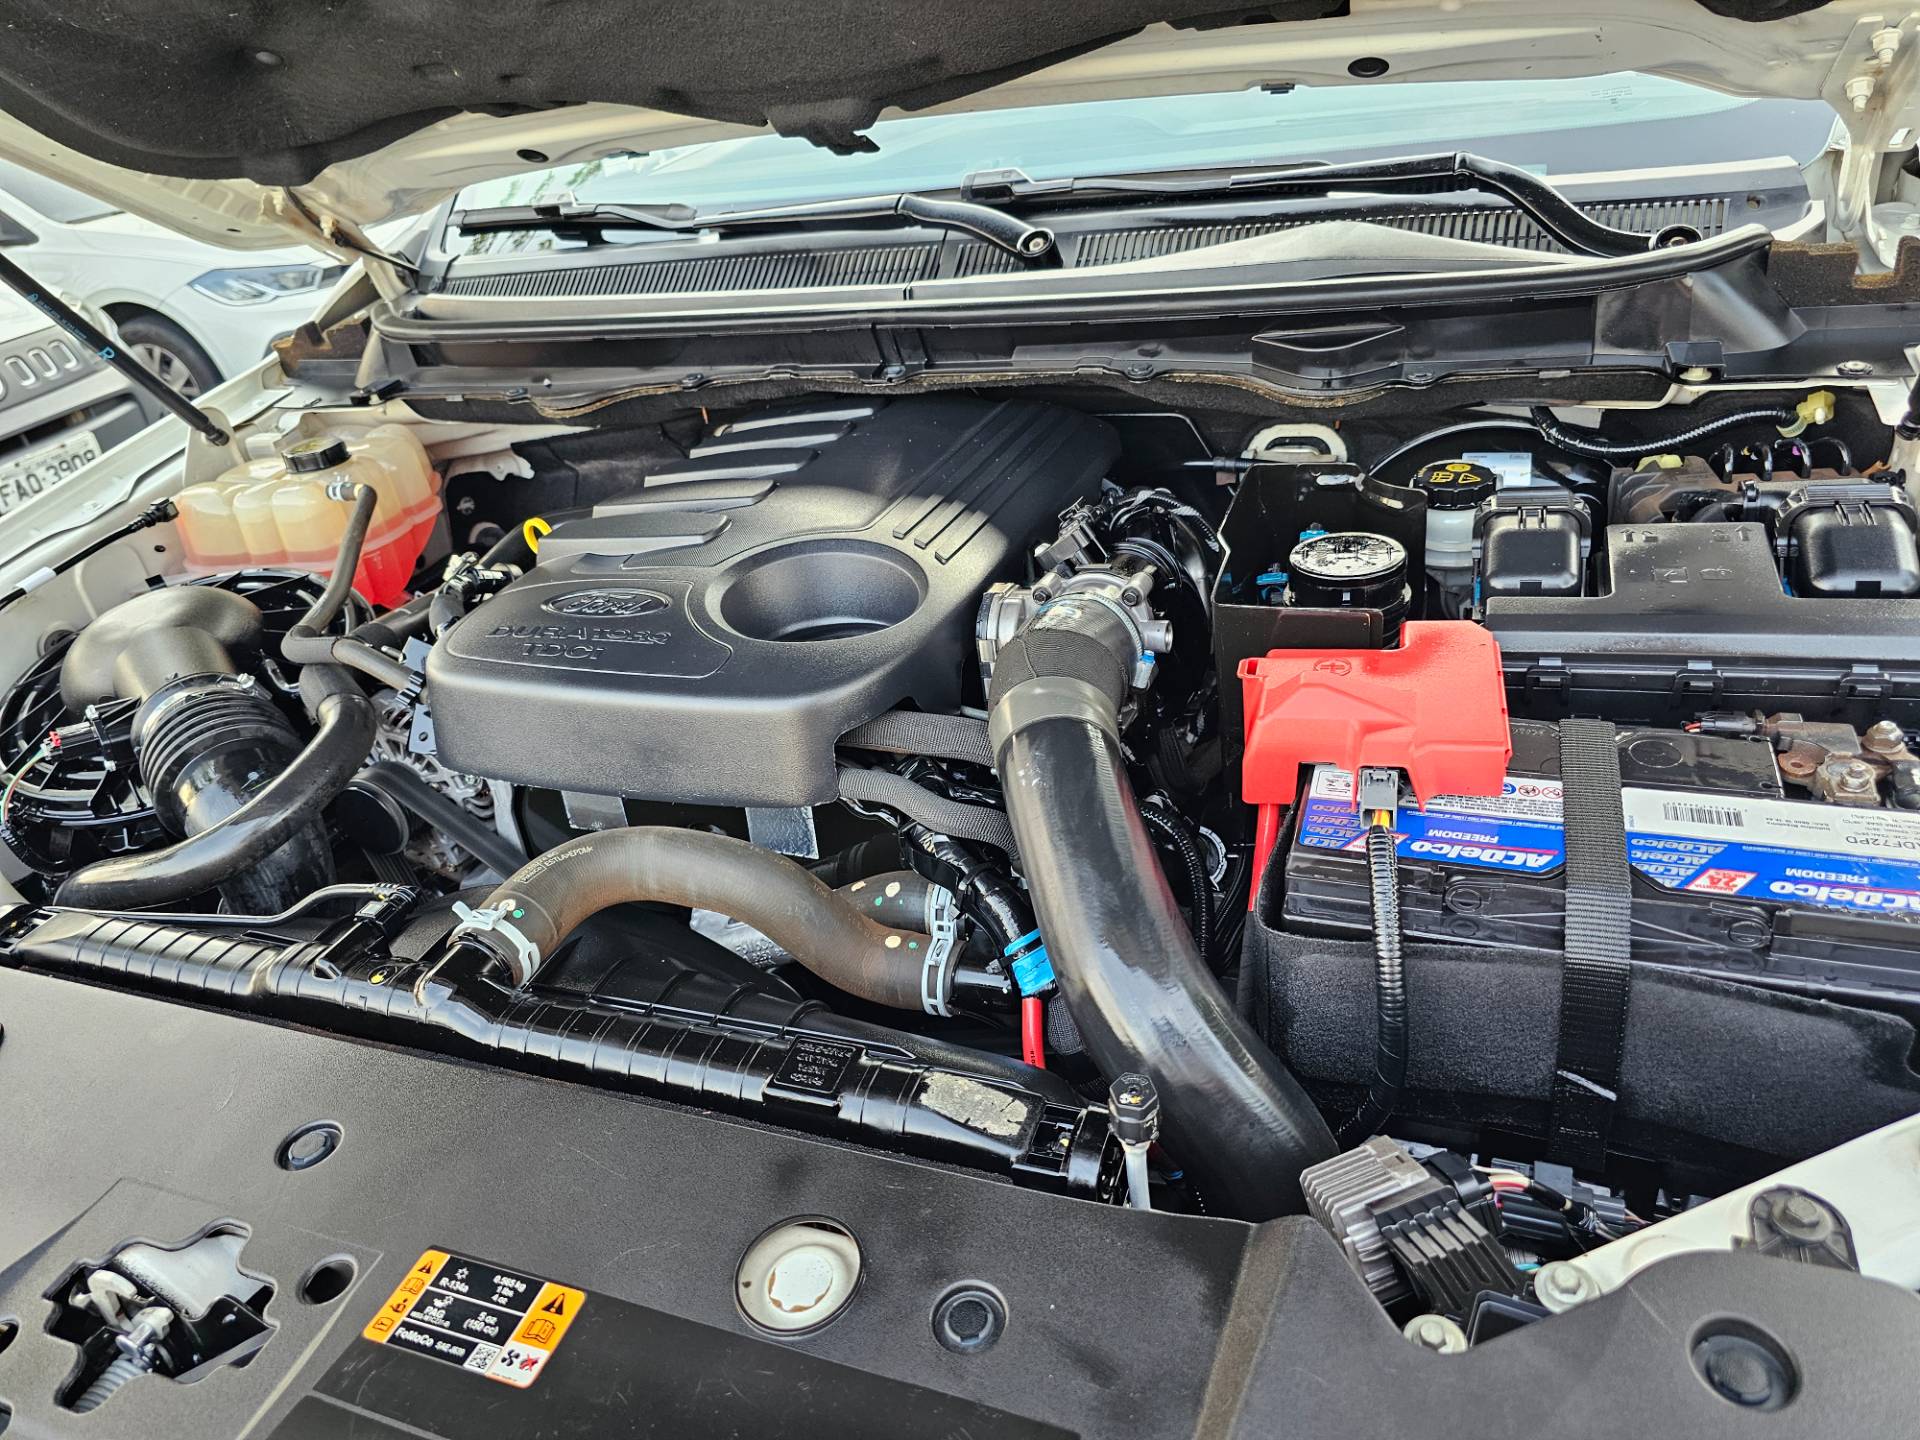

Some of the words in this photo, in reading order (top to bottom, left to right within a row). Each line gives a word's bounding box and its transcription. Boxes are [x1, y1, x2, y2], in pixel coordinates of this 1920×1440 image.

[563, 592, 652, 614] Ford
[1428, 829, 1500, 843] FREEDOM
[1410, 841, 1554, 867] ACDelco
[1630, 838, 1725, 854] ACDelco
[1707, 874, 1738, 887] 24
[1785, 868, 1870, 884] FREEDOM
[438, 1277, 470, 1293] R-134a
[491, 1293, 498, 1302] 4
[498, 1296, 509, 1306] oz
[423, 1306, 446, 1319] PAG
[477, 1311, 487, 1321] 5
[485, 1315, 498, 1325] oz
[463, 1318, 485, 1333] (150
[483, 1324, 499, 1338] cc)
[394, 1327, 434, 1348] FoMoCo
